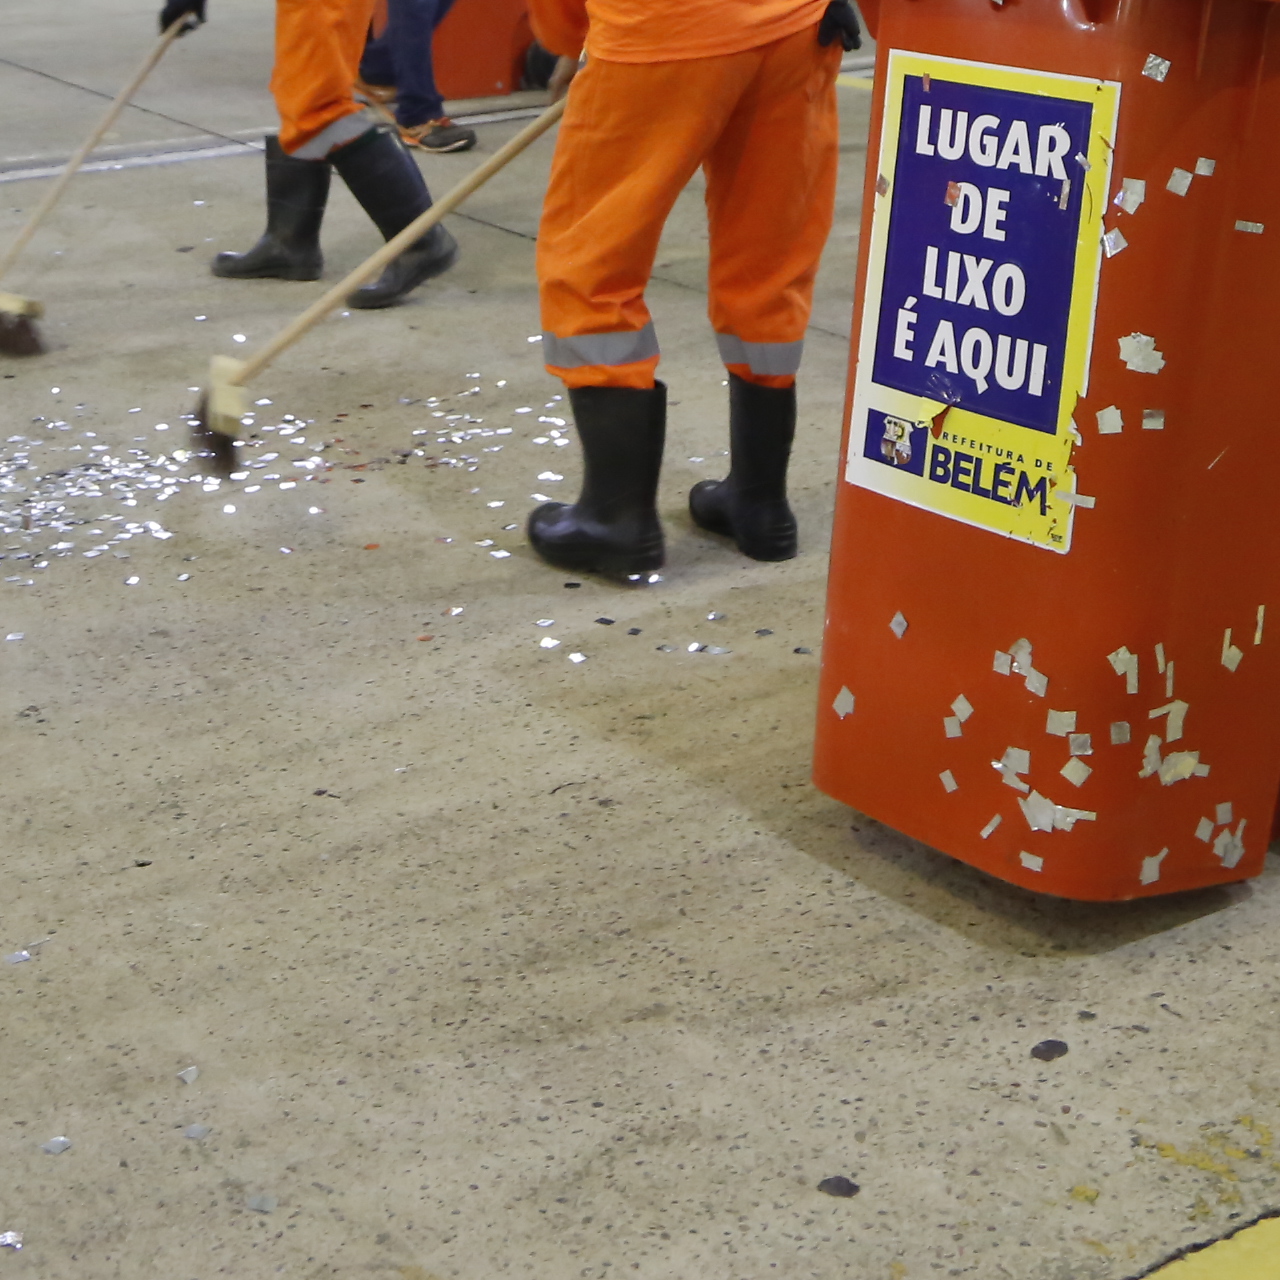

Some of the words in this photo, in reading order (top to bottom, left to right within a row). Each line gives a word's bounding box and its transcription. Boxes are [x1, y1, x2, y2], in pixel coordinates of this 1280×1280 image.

[915, 103, 1072, 181] LUGAR
[949, 182, 1011, 242] DE
[922, 246, 1026, 317] LIXO
[892, 296, 918, 362] É
[924, 319, 1048, 397] AQUI
[929, 443, 1047, 517] BELÉM
[1034, 458, 1053, 471] DE
